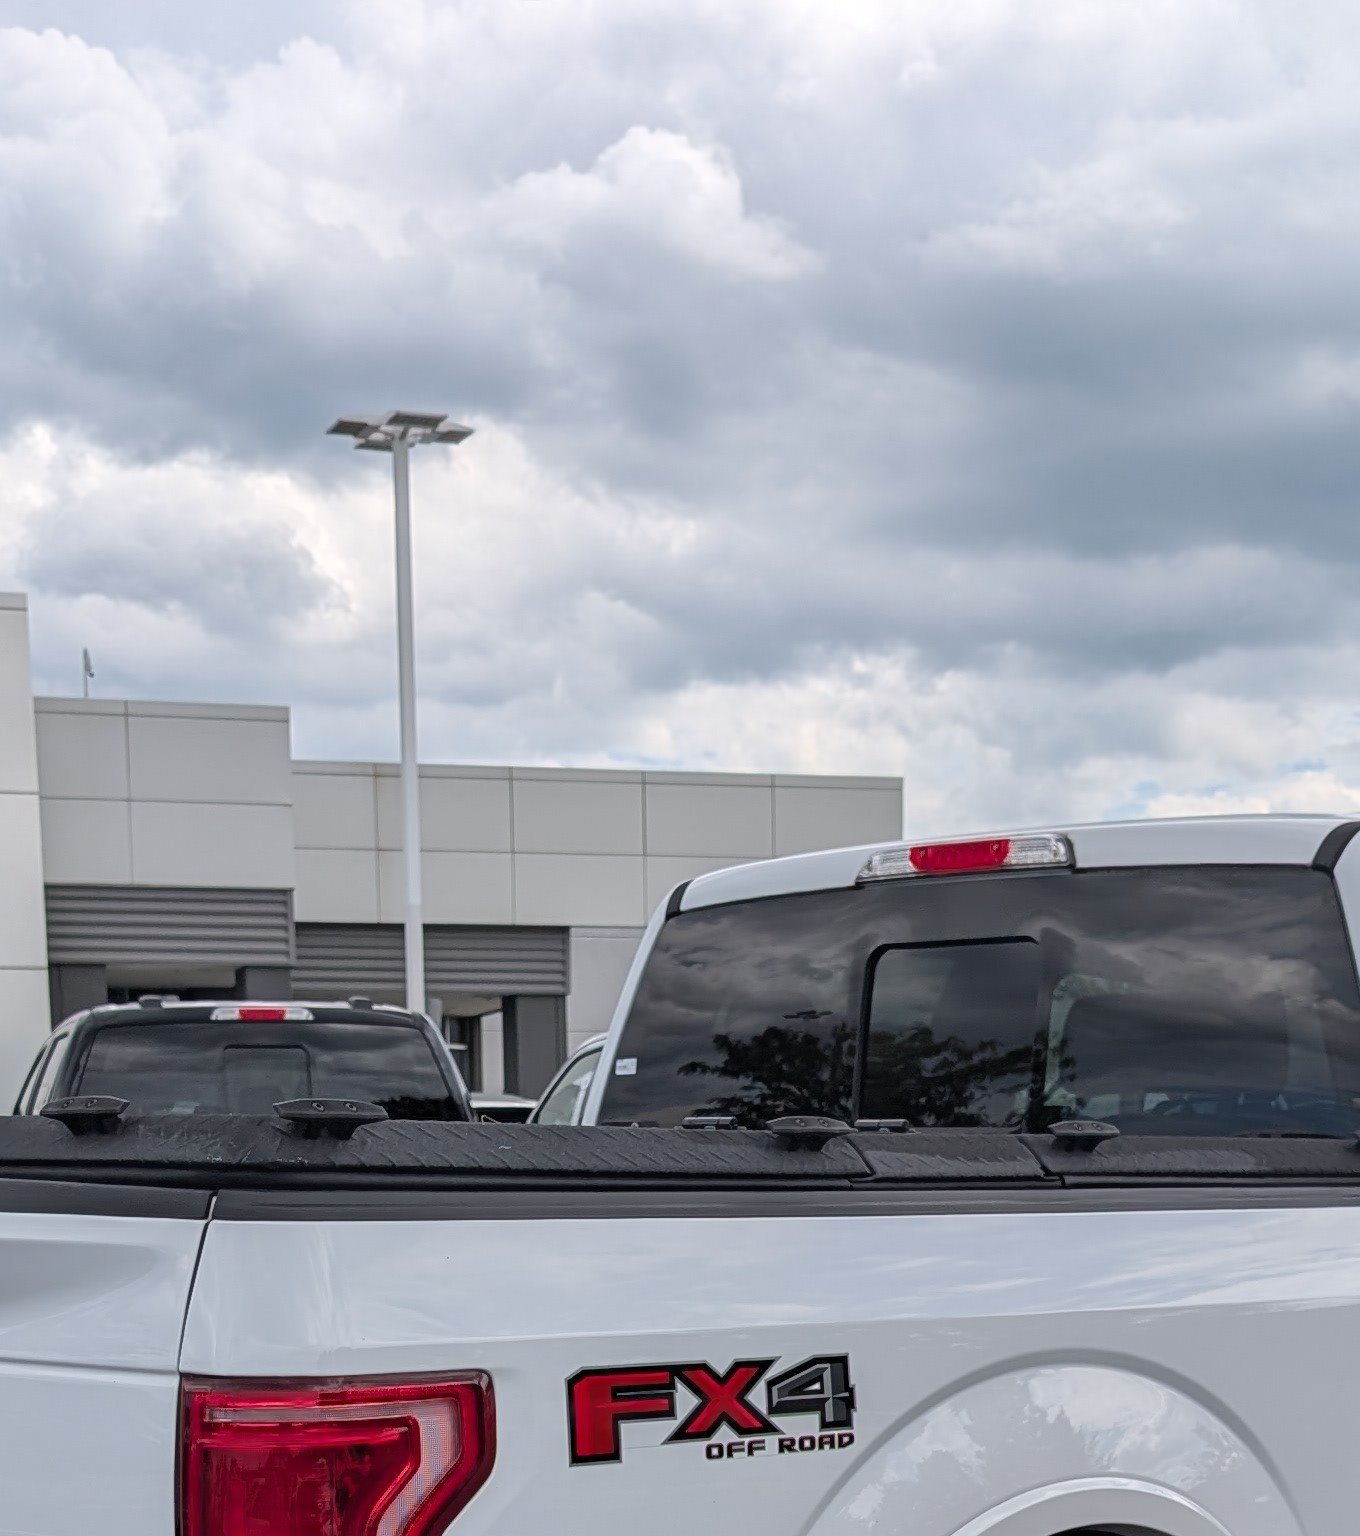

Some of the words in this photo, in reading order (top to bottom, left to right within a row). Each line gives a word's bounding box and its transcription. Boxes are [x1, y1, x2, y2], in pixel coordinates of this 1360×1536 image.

[565, 1353, 856, 1467] FX4
[706, 1439, 766, 1460] OFF
[778, 1433, 855, 1455] ROAD
